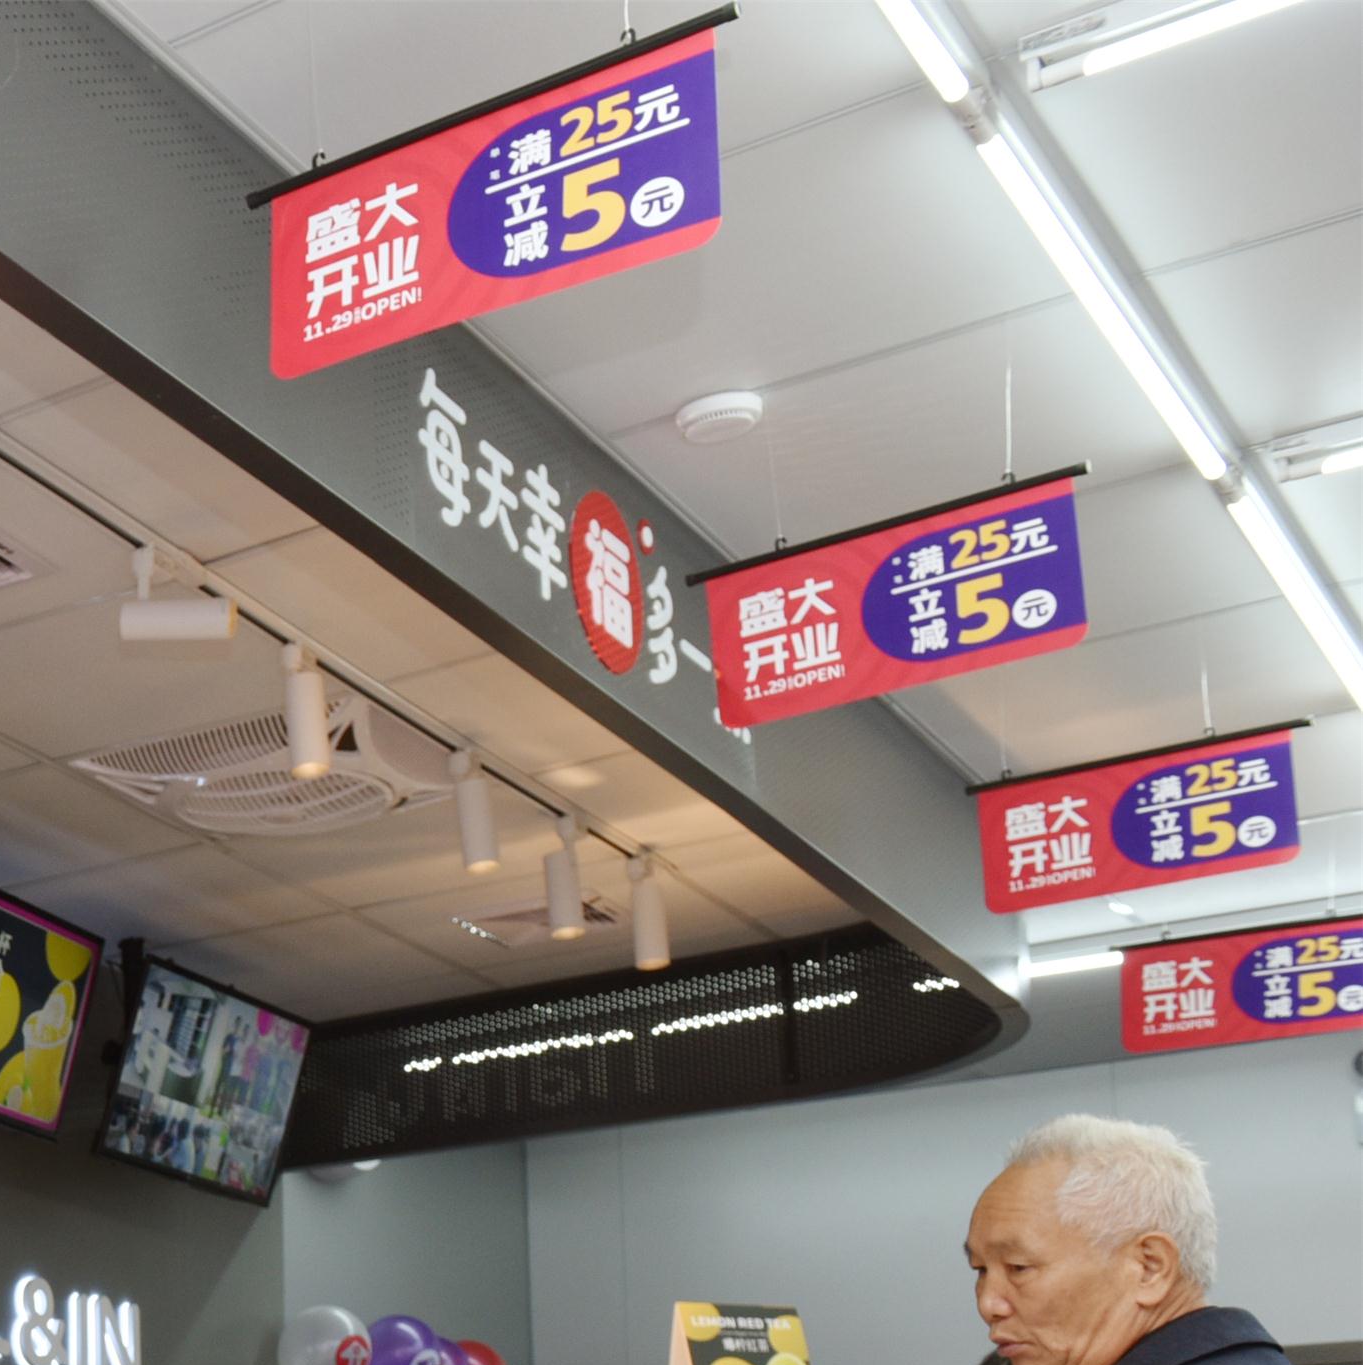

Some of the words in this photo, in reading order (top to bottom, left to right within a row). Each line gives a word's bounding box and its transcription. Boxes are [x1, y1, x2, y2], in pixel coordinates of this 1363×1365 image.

[305, 181, 419, 263] 盛大
[560, 158, 626, 252] 5
[640, 184, 675, 216] 元
[306, 236, 420, 319] 开业
[418, 368, 752, 744] 每天幸福多一
[739, 577, 836, 637] 盛大
[955, 573, 1009, 645] 5
[1021, 596, 1049, 620] 元
[743, 622, 841, 682] 开业
[1005, 796, 1089, 840] 盛大
[1190, 802, 1236, 857] 5
[1009, 833, 1093, 877] 开业
[691, 1315, 734, 1329] LEMON
[737, 1317, 766, 1330] RED
[767, 1317, 792, 1331] TEA
